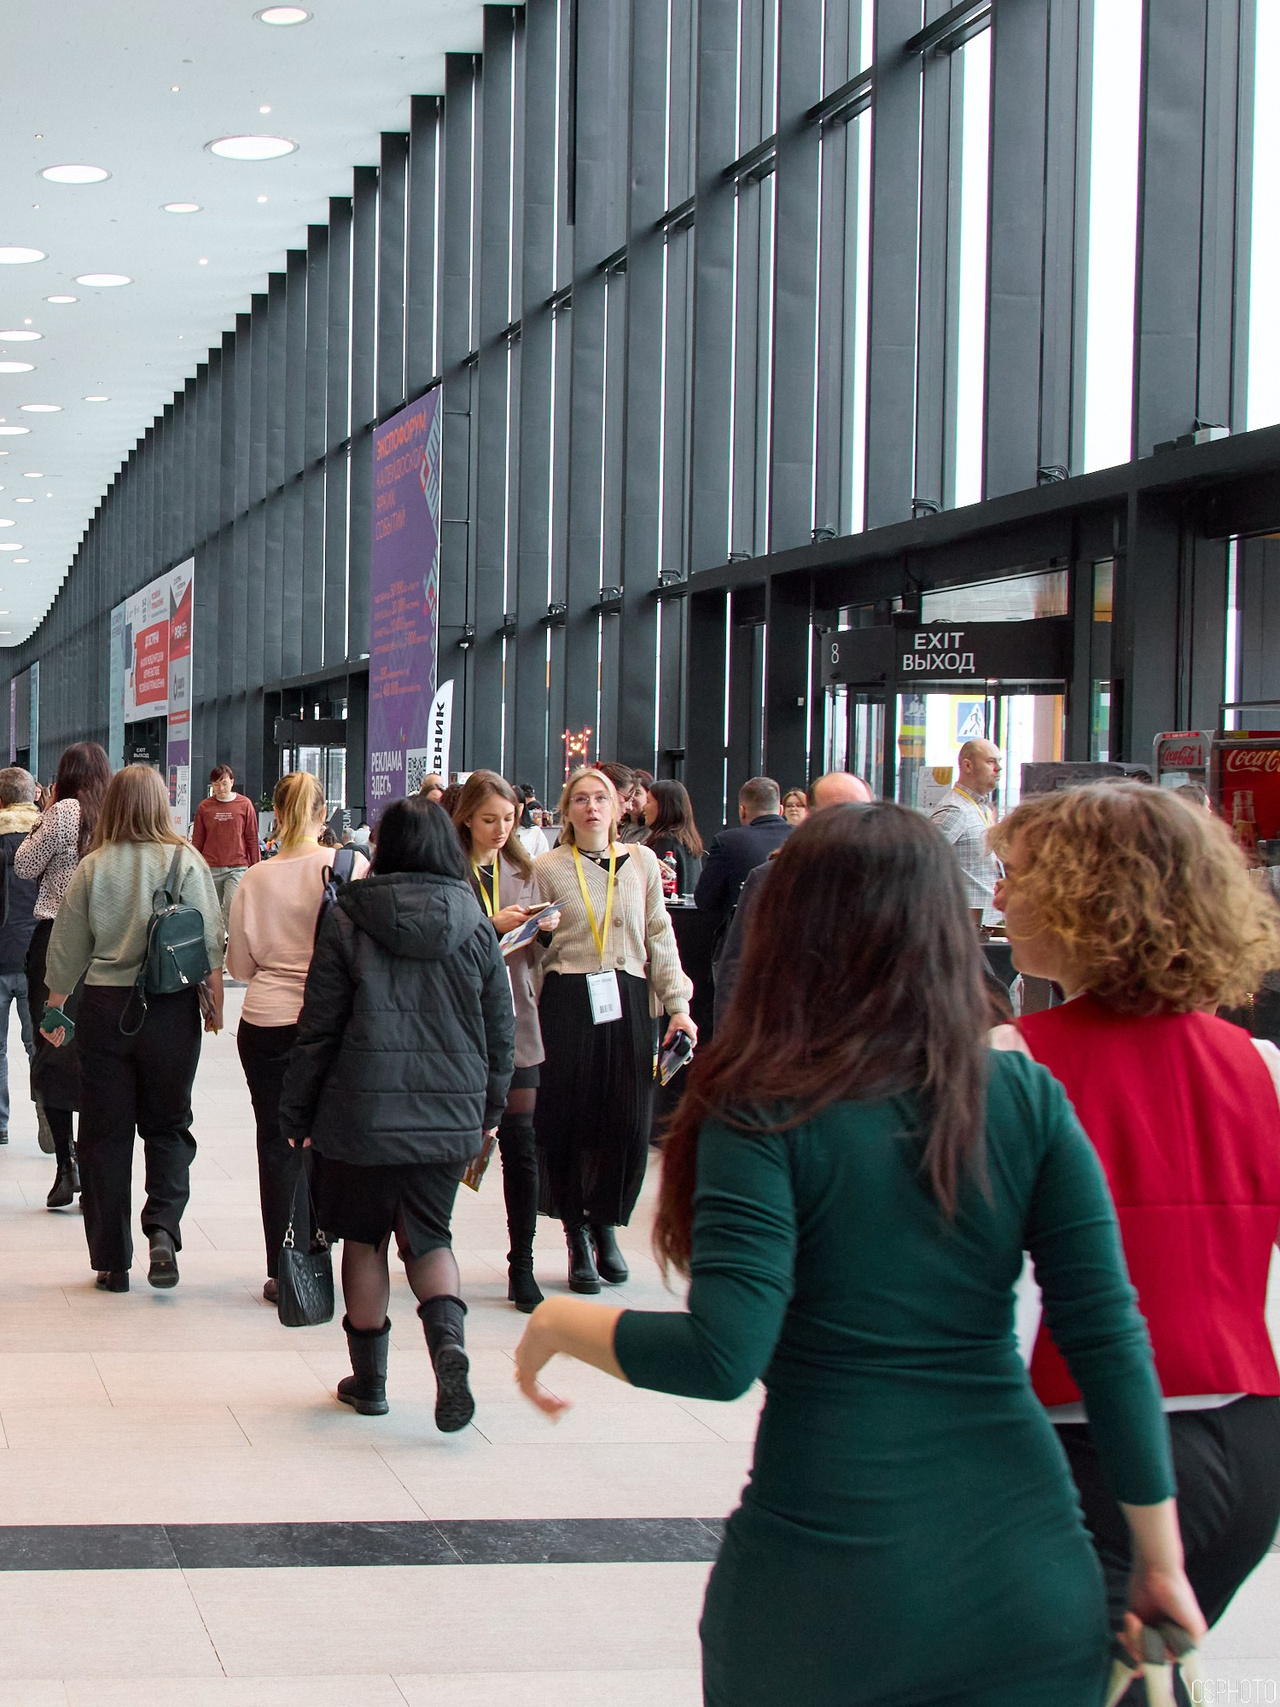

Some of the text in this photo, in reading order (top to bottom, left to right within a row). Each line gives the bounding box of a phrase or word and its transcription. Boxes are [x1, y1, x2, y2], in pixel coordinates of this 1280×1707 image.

[913, 632, 965, 650] EXIT
[830, 642, 840, 664] 8
[902, 652, 976, 674] ВЫХОД
[371, 750, 403, 773] РЕКЛАМА
[1226, 749, 1280, 773] Coca-C
[371, 775, 392, 799] ЗДЕСЬ
